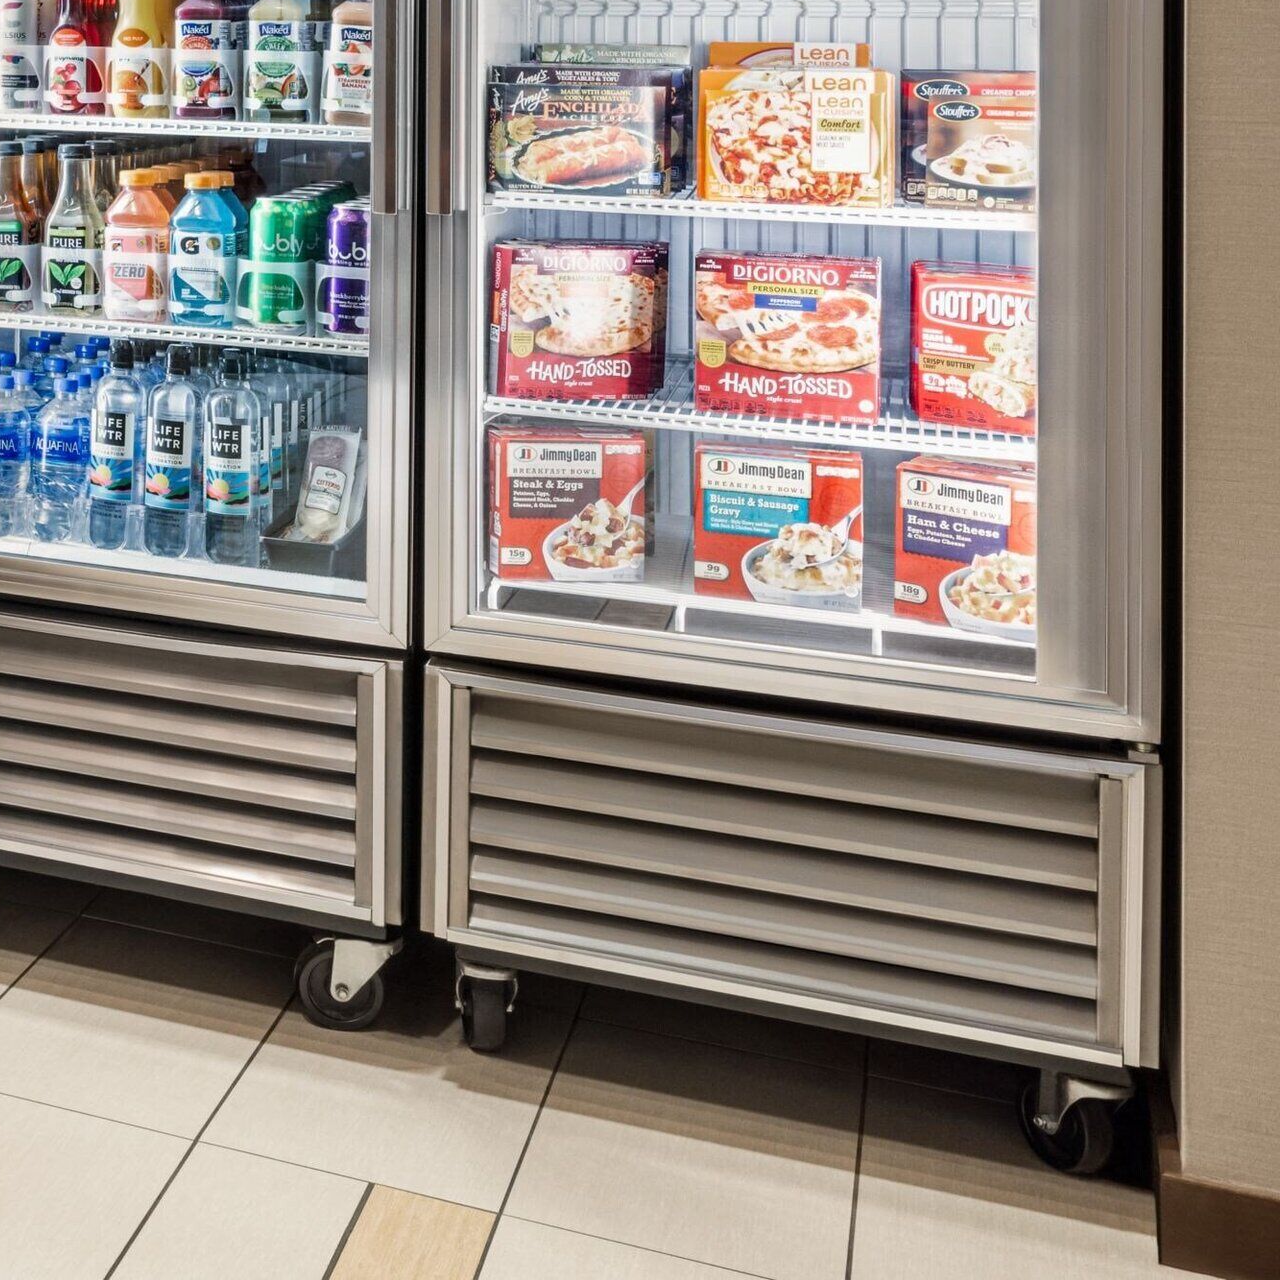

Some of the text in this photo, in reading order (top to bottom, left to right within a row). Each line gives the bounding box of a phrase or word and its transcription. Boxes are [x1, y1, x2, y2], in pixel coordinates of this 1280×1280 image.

[800, 48, 849, 62] Lean
[515, 68, 551, 84] Amy's
[812, 76, 867, 91] Lean
[920, 84, 964, 97] Stouffer's
[511, 87, 552, 116] Amy's
[817, 96, 864, 109] Lean
[938, 105, 978, 118] Stouffer's
[819, 118, 863, 130] Comfort
[52, 238, 83, 249] PURE
[114, 265, 146, 279] ZERO
[752, 285, 820, 296] PERSONAL SIZE
[526, 357, 633, 384] HAND-TOSSED
[718, 371, 853, 400] HAND-TOSSED
[153, 423, 181, 438] LIFE
[211, 428, 239, 441] LIFE
[153, 437, 181, 450] WTR
[211, 441, 240, 455] WTR
[540, 448, 573, 463] Jimmy
[573, 449, 598, 462] Dean
[512, 467, 567, 475] BREAKFAST
[738, 462, 776, 480] Jimmy
[777, 465, 805, 481] Dean
[513, 479, 584, 491] Steak & Eggs
[937, 482, 1004, 507] Jimmy Dean
[709, 493, 800, 512] Biscuit & Sausage
[709, 504, 742, 518] Gravy
[907, 514, 1001, 540] Ham & Cheese
[509, 549, 526, 559] 15g
[902, 584, 921, 596] 18g
